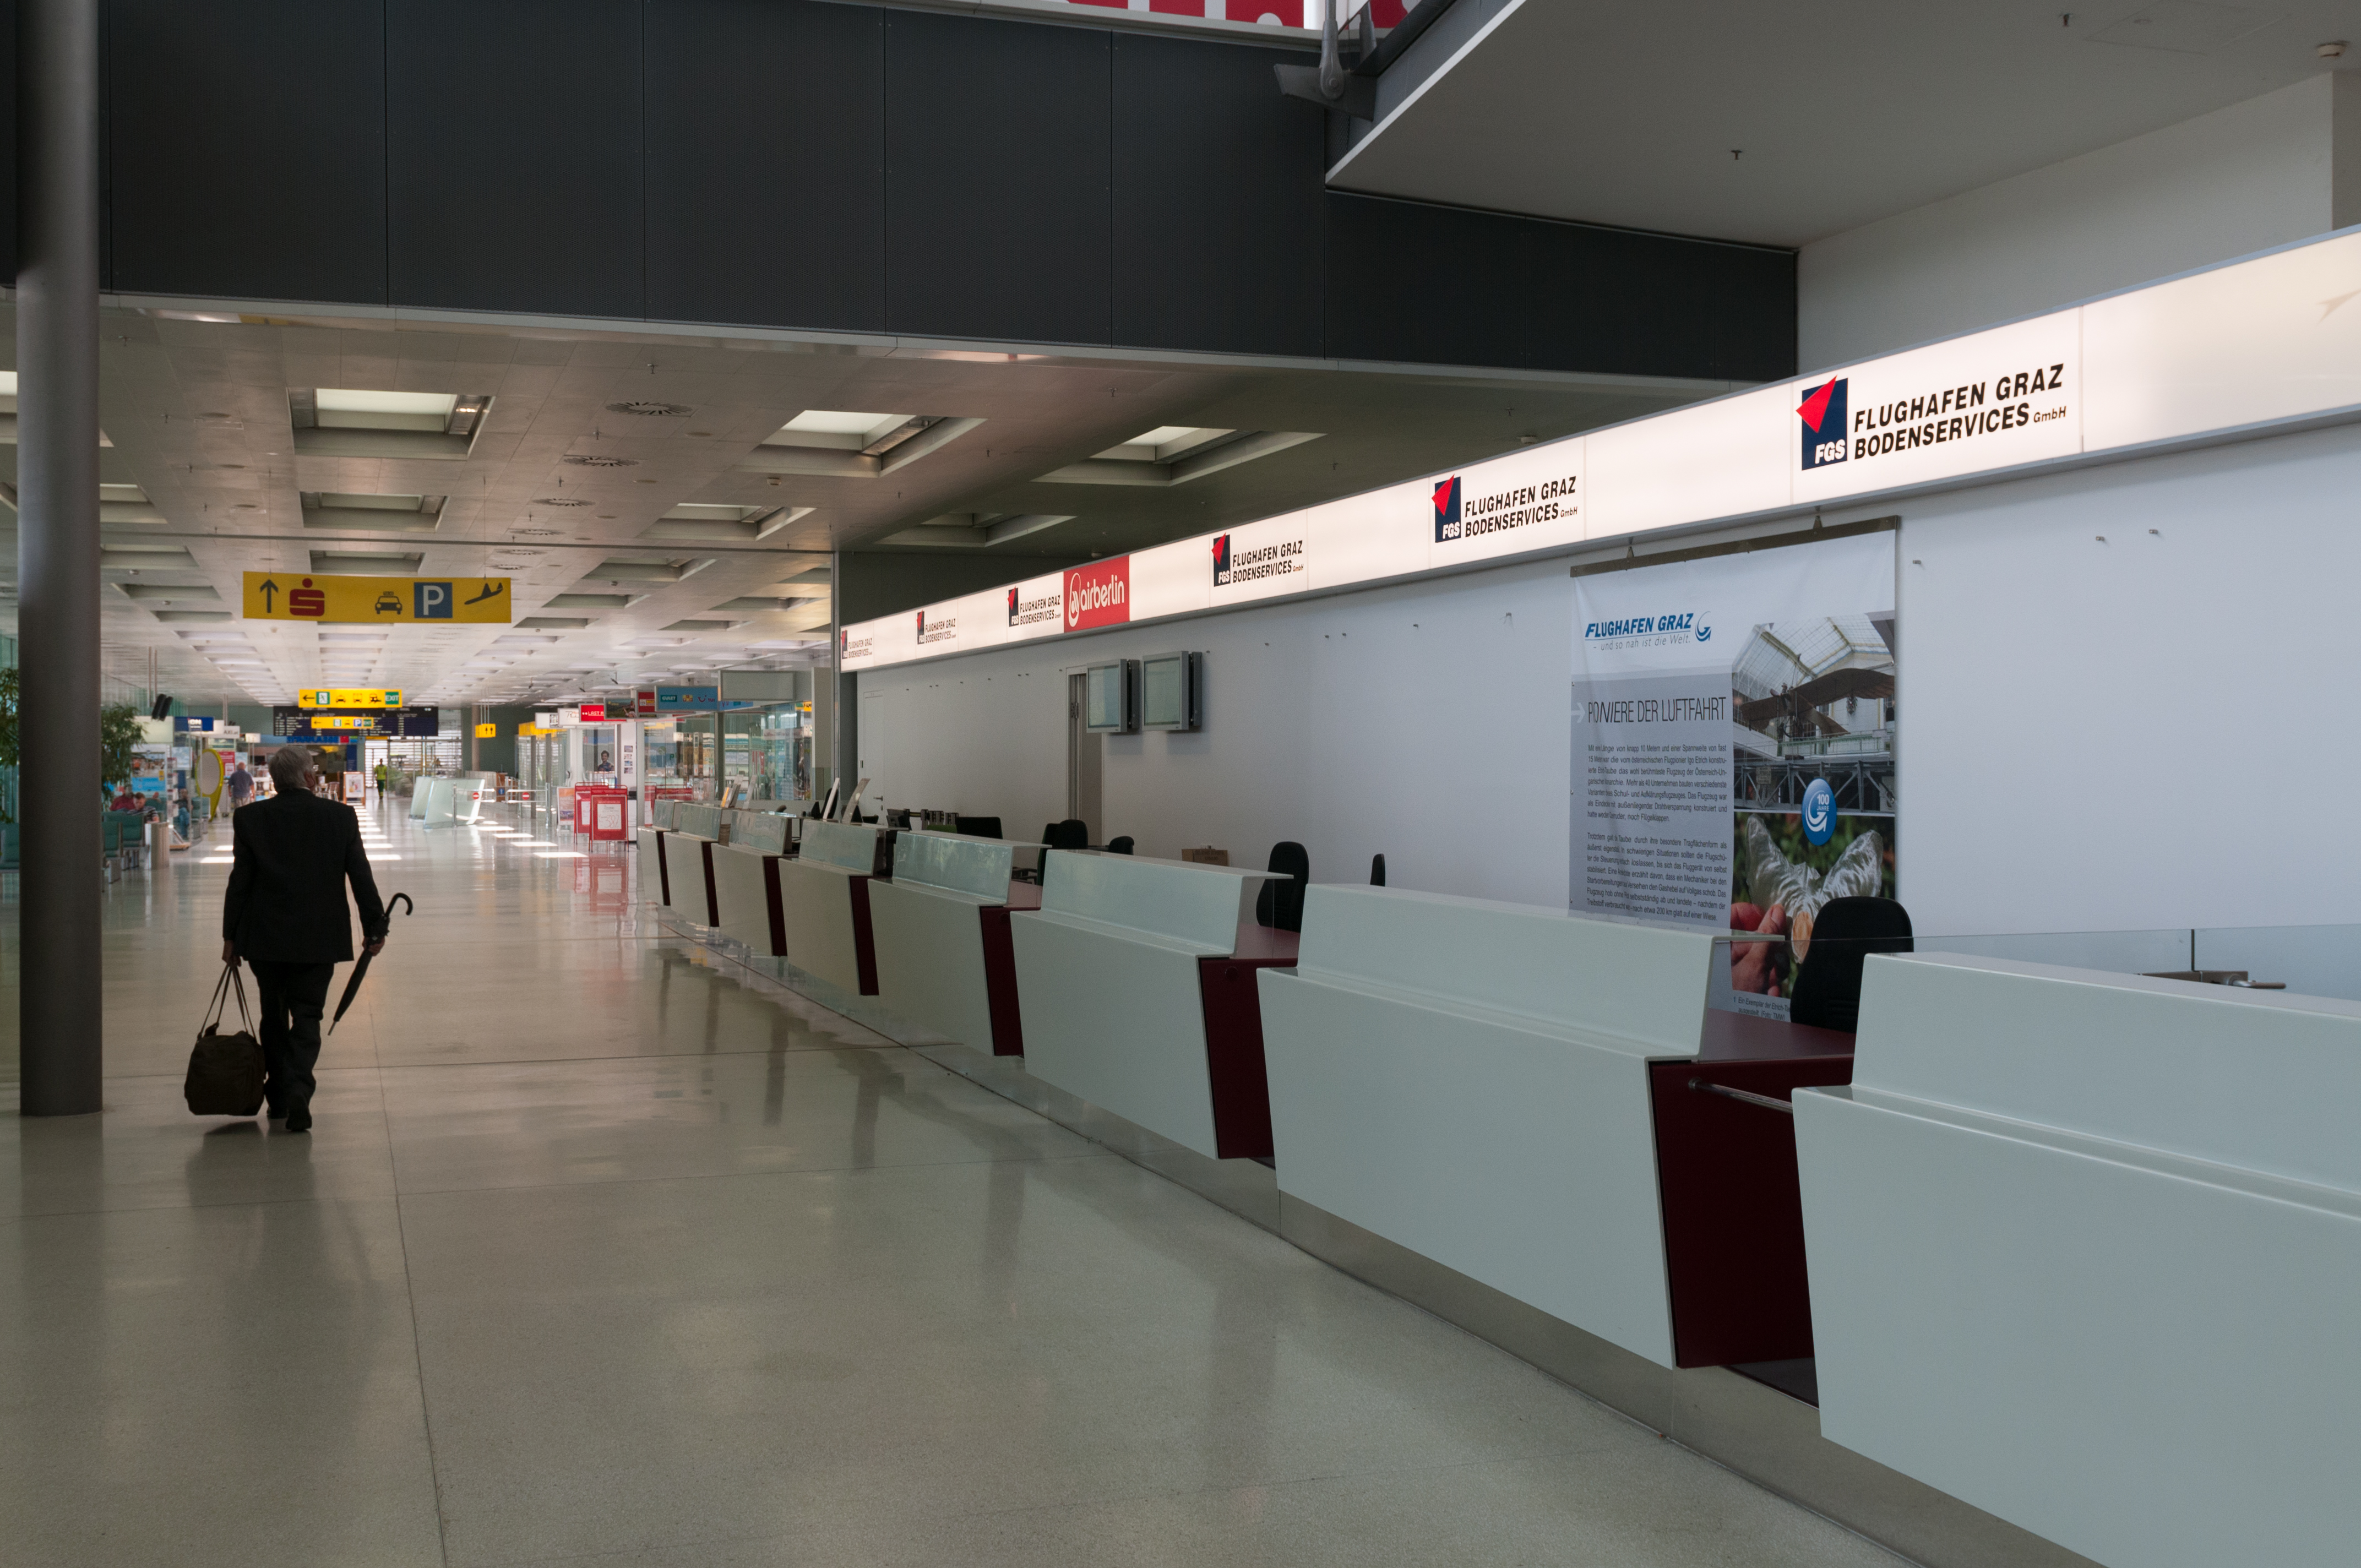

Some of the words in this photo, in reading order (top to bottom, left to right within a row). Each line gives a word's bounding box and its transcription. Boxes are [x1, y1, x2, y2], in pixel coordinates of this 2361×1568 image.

[1854, 382, 1985, 432] FLUGHAFEN
[1996, 363, 2064, 400] GRAZ
[1854, 402, 2030, 460] BODENSERVICES
[2033, 406, 2066, 422] GmbH
[1815, 439, 1845, 464] FGS
[1465, 486, 1536, 518] FLUGHAFEN
[1541, 476, 1576, 500] GRAZ
[1465, 502, 1559, 537] BODENSERVICES
[1560, 507, 1577, 518] GmbH
[1443, 522, 1460, 539] FGS
[1233, 546, 1277, 567] FLUGHAFEN
[1281, 540, 1303, 557] GRAZ
[1218, 570, 1230, 584] FGS
[1233, 560, 1292, 583] BODENSERVICES
[423, 585, 444, 616] P
[1080, 574, 1124, 611] airberlin
[1020, 598, 1046, 613] FLUGHAFEN
[1048, 595, 1060, 607] GRAZ
[1020, 609, 1054, 625] BODENSERVICES
[926, 620, 945, 633] FLUGHAFEN
[946, 618, 955, 628] GRAZ
[1585, 617, 1654, 638] FLUGHAFEN
[1657, 613, 1694, 631] GRAZ
[926, 630, 951, 643] BODENSERVICES
[1601, 640, 1613, 651] und
[1626, 638, 1639, 648] nah
[1642, 638, 1651, 647] ist
[1655, 636, 1666, 646] die
[1670, 634, 1690, 644] Welt.
[1588, 701, 1634, 723] PONIERE
[1638, 700, 1658, 722] DER
[1662, 697, 1726, 722] LUFTFAHRT
[1627, 745, 1639, 753] knapp
[1682, 744, 1707, 753] Spannweite
[1664, 756, 1686, 765] Flugpionier
[1666, 767, 1685, 777] Flugzeug
[1698, 792, 1717, 802] Flugzeug
[1817, 794, 1829, 805] 100
[1694, 804, 1716, 812] konstruiert
[1660, 837, 1681, 846] besondere
[1626, 847, 1655, 857] schwierigen
[1656, 849, 1679, 857] Situationen
[1684, 874, 1709, 884] Mechaniker
[1587, 888, 1604, 897] Flugzeug
[1677, 897, 1692, 906] landete
[1698, 900, 1717, 908] nachdem
[1658, 884, 1678, 892] Gashebel
[1686, 886, 1702, 896] Vollgas
[1718, 889, 1726, 897] Das
[1772, 1003, 1789, 1012] Etrich-Ta
